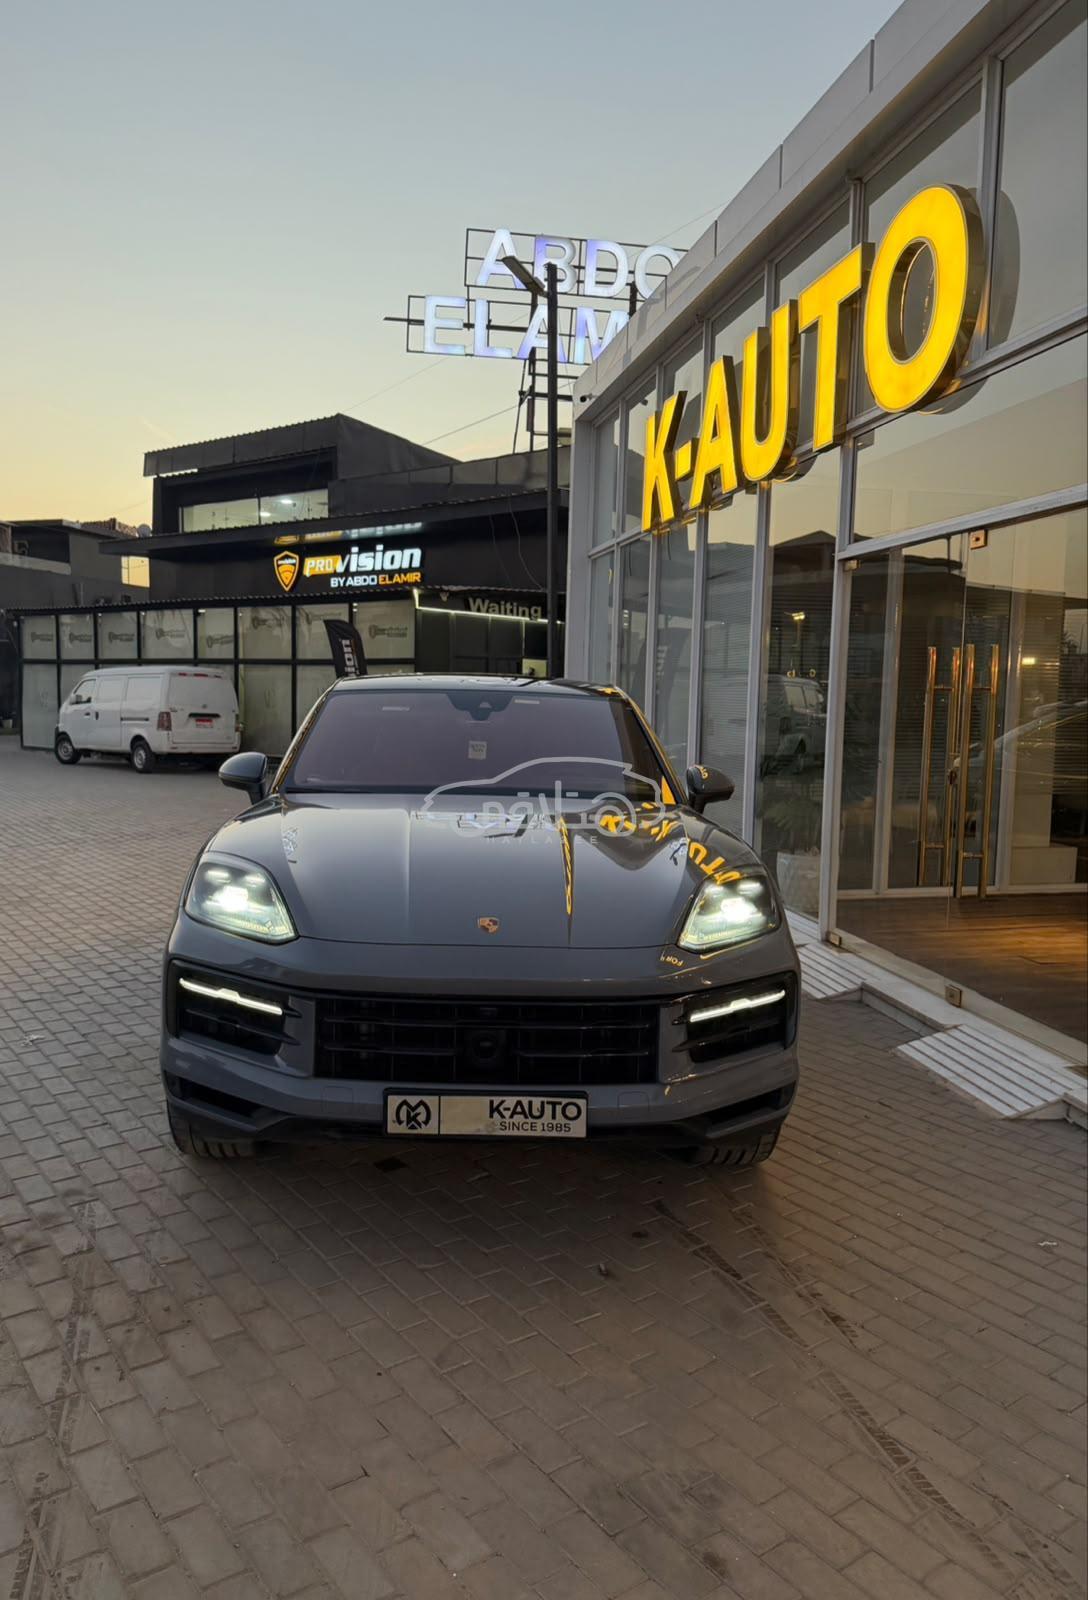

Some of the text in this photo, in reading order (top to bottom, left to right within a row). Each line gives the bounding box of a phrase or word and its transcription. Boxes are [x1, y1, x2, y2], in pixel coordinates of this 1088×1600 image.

[475, 228, 682, 299] ABDO
[641, 184, 973, 533] K-AUTO
[330, 572, 421, 588] BY ABDO ELAMIR
[468, 597, 542, 621] Waiting
[489, 1099, 582, 1121] K-AUTO
[499, 1121, 572, 1133] SINCE 1985
